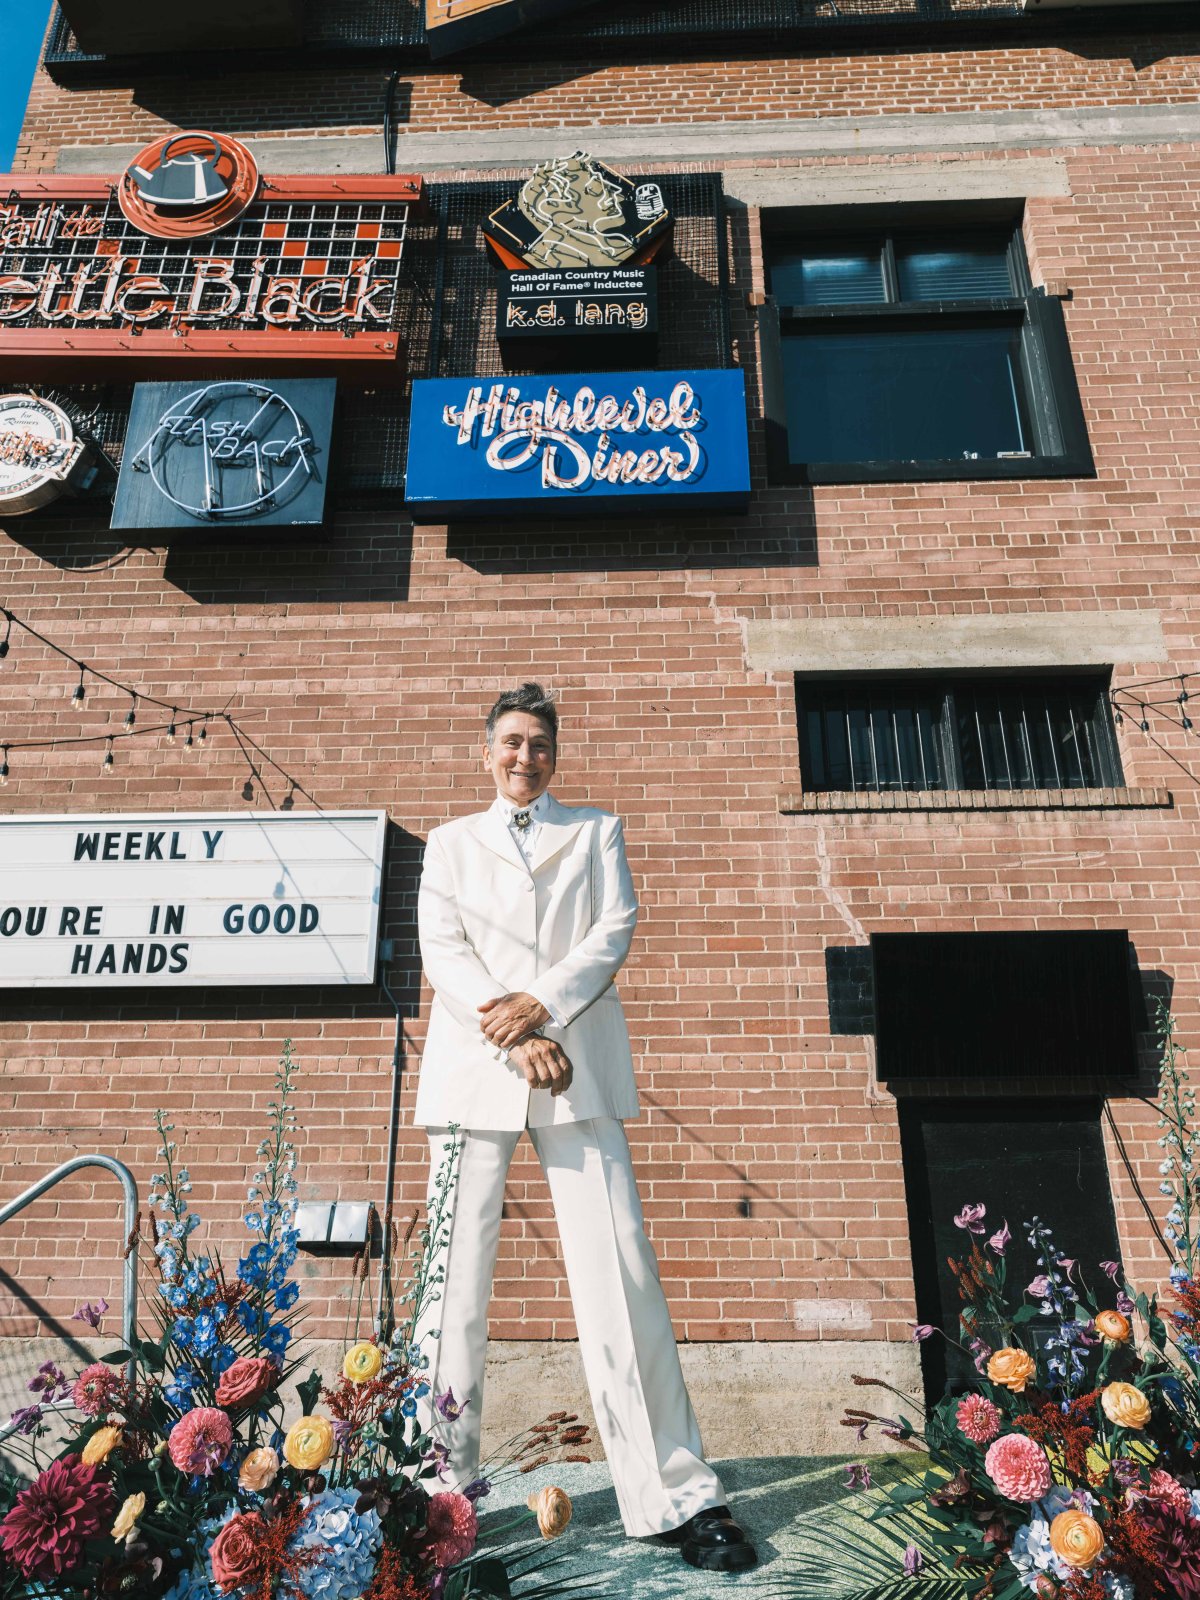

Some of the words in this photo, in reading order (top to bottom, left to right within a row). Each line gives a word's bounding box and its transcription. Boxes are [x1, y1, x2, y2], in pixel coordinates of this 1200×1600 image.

[61, 204, 105, 238] the
[188, 253, 393, 324] Black
[509, 272, 562, 282] Canadian
[564, 270, 611, 280] Country
[612, 269, 645, 279] Music
[511, 283, 533, 292] Hall
[536, 282, 551, 291] Of
[593, 280, 644, 290] Inductee
[505, 300, 566, 328] k.d.
[575, 300, 649, 329] lang
[18, 401, 62, 431] ORIGINAL
[442, 380, 701, 470] Highlevel
[542, 430, 701, 489] Diner
[73, 830, 224, 861] WEEKLY
[149, 904, 185, 934] IN
[222, 903, 320, 934] GOOD
[70, 943, 190, 974] HANDS
